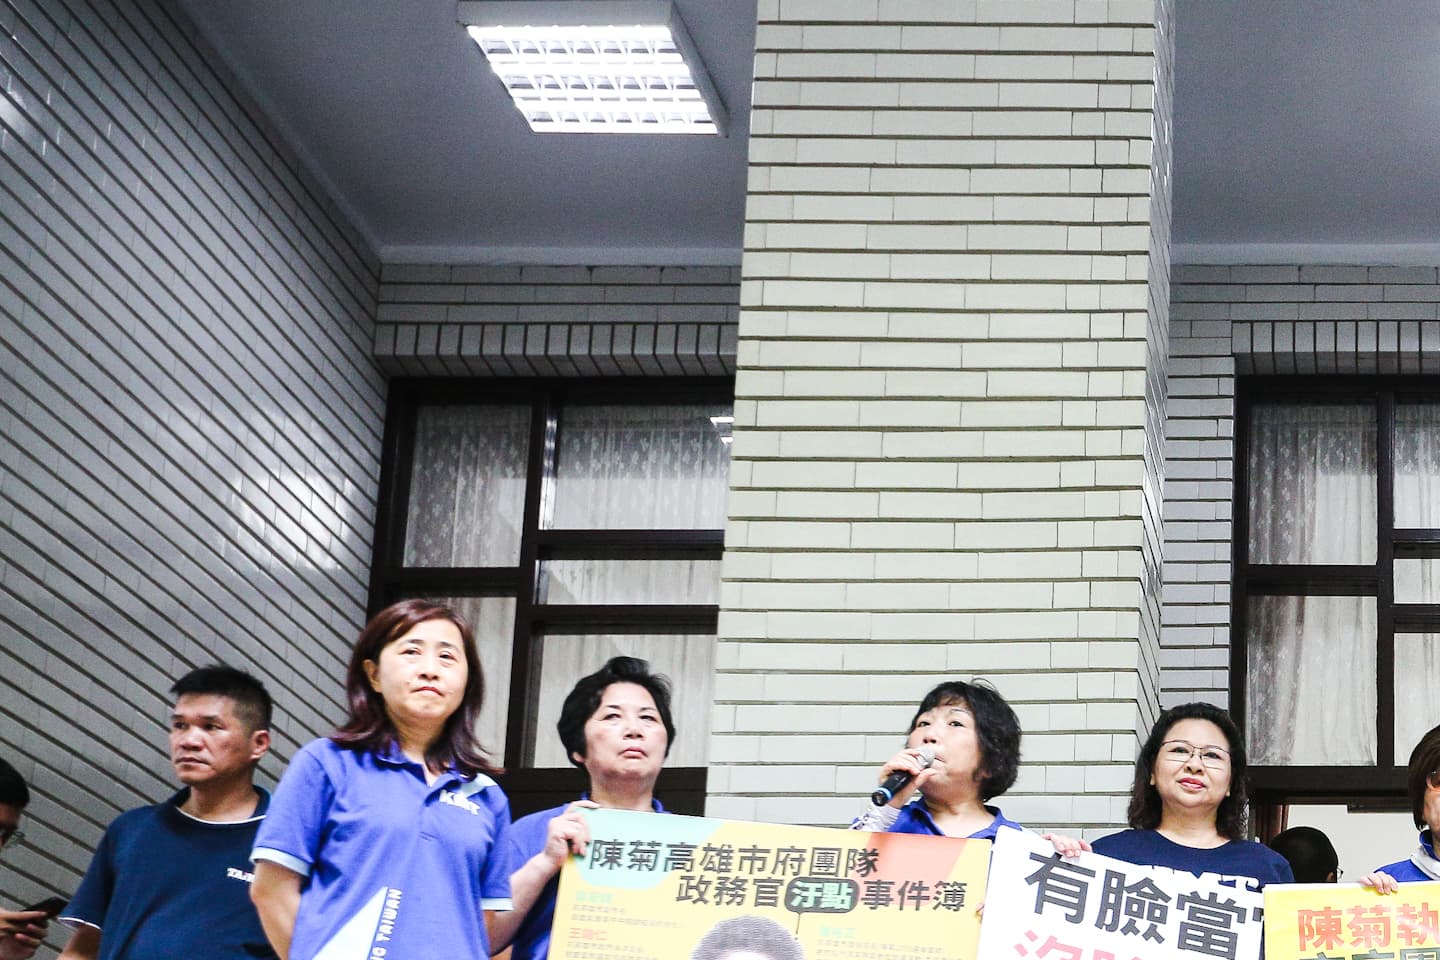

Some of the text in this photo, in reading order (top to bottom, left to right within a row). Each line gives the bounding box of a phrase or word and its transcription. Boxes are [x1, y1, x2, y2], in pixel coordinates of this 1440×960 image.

[589, 839, 879, 878] 陳菊高雄市府團隊
[376, 888, 403, 942] TAIWAN
